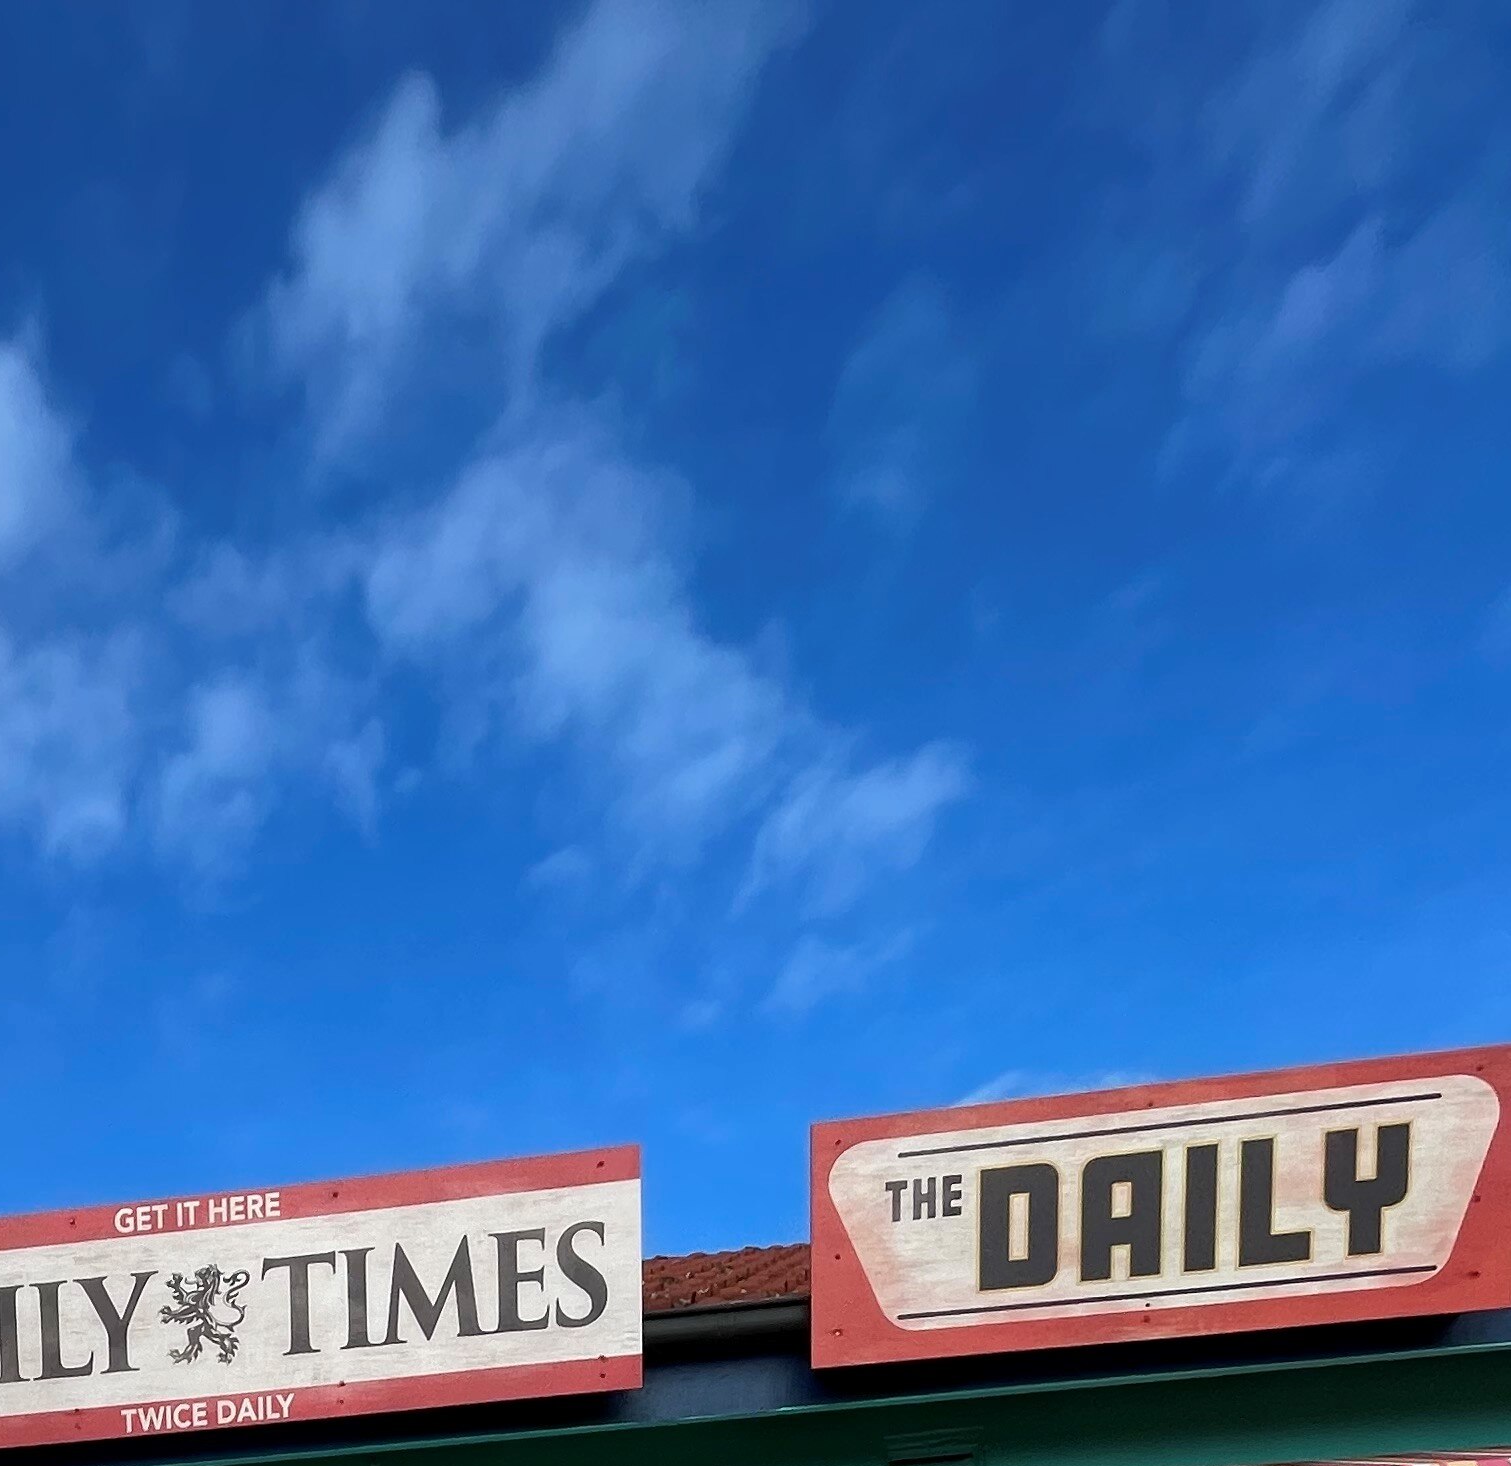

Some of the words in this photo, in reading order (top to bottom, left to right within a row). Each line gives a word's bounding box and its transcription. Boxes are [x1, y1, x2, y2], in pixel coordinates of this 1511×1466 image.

[115, 1204, 169, 1234] GET
[176, 1200, 200, 1228] IT
[208, 1191, 281, 1224] HERE
[886, 1173, 963, 1222] THE
[978, 1122, 1412, 1292] DAILY
[261, 1220, 609, 1356] TIMES
[121, 1402, 208, 1434] TWICE
[216, 1393, 295, 1426] DAILY
